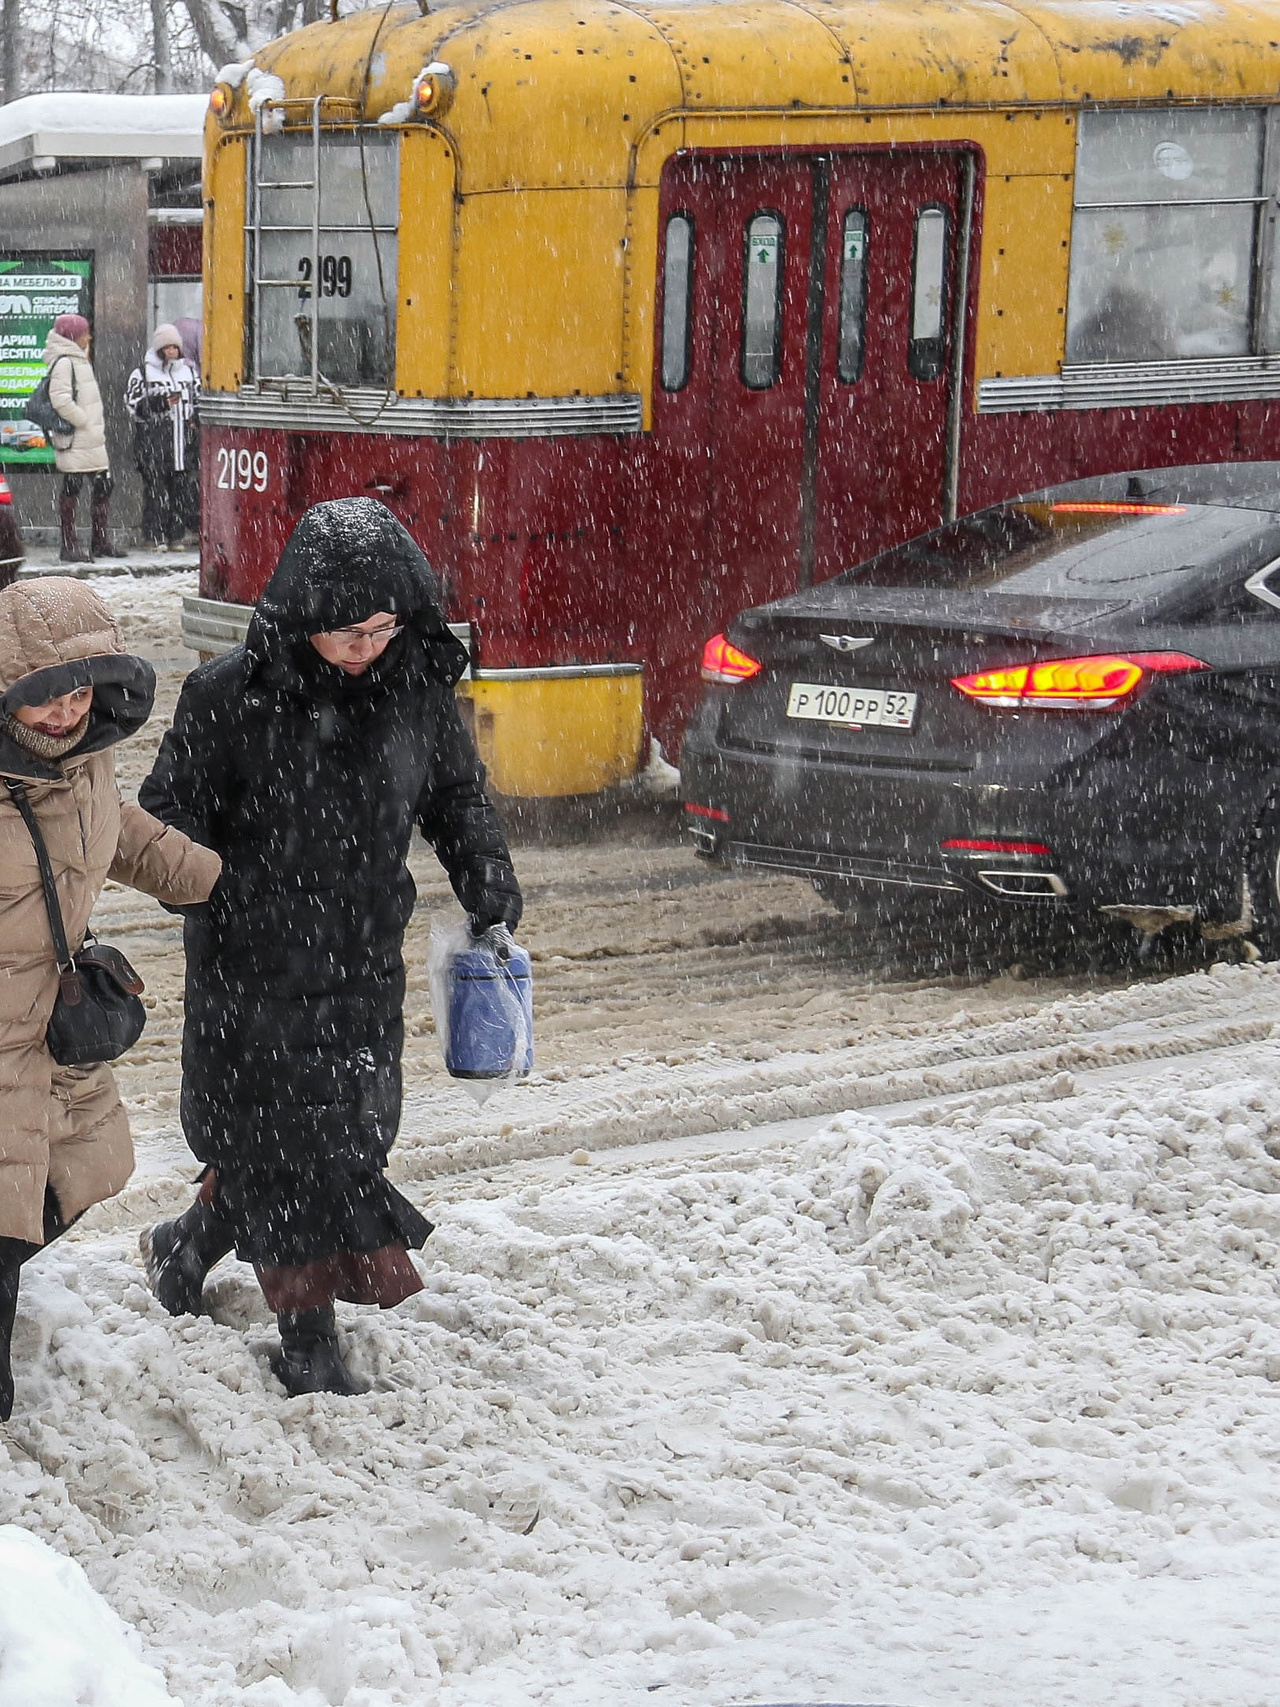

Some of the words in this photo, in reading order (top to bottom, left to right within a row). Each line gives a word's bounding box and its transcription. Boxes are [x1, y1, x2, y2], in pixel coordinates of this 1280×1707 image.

[13, 277, 67, 288] МЕБЕЛЬЮ
[70, 277, 77, 287] В
[298, 255, 352, 298] 2199
[32, 294, 79, 305] ОТКРЫТЫЙ
[217, 447, 268, 492] 2199
